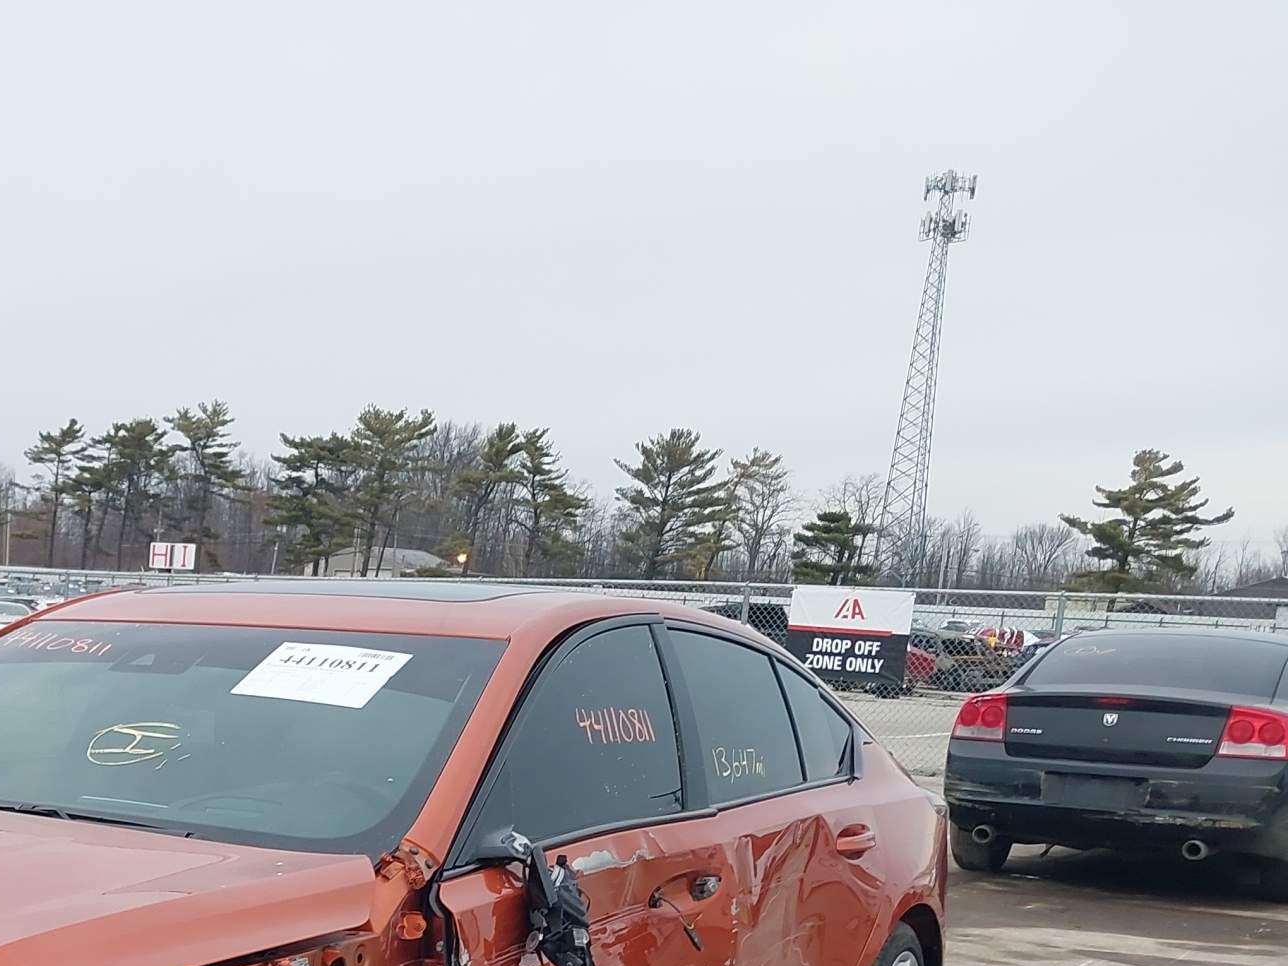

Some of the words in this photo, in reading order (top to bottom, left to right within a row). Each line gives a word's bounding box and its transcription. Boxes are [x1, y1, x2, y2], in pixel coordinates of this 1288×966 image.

[812, 637, 852, 654] DROP
[854, 640, 881, 656] OFF
[280, 655, 380, 673] 44110811
[804, 654, 843, 671] ZONE
[845, 657, 884, 674] ONLY
[575, 707, 656, 745] 44110811
